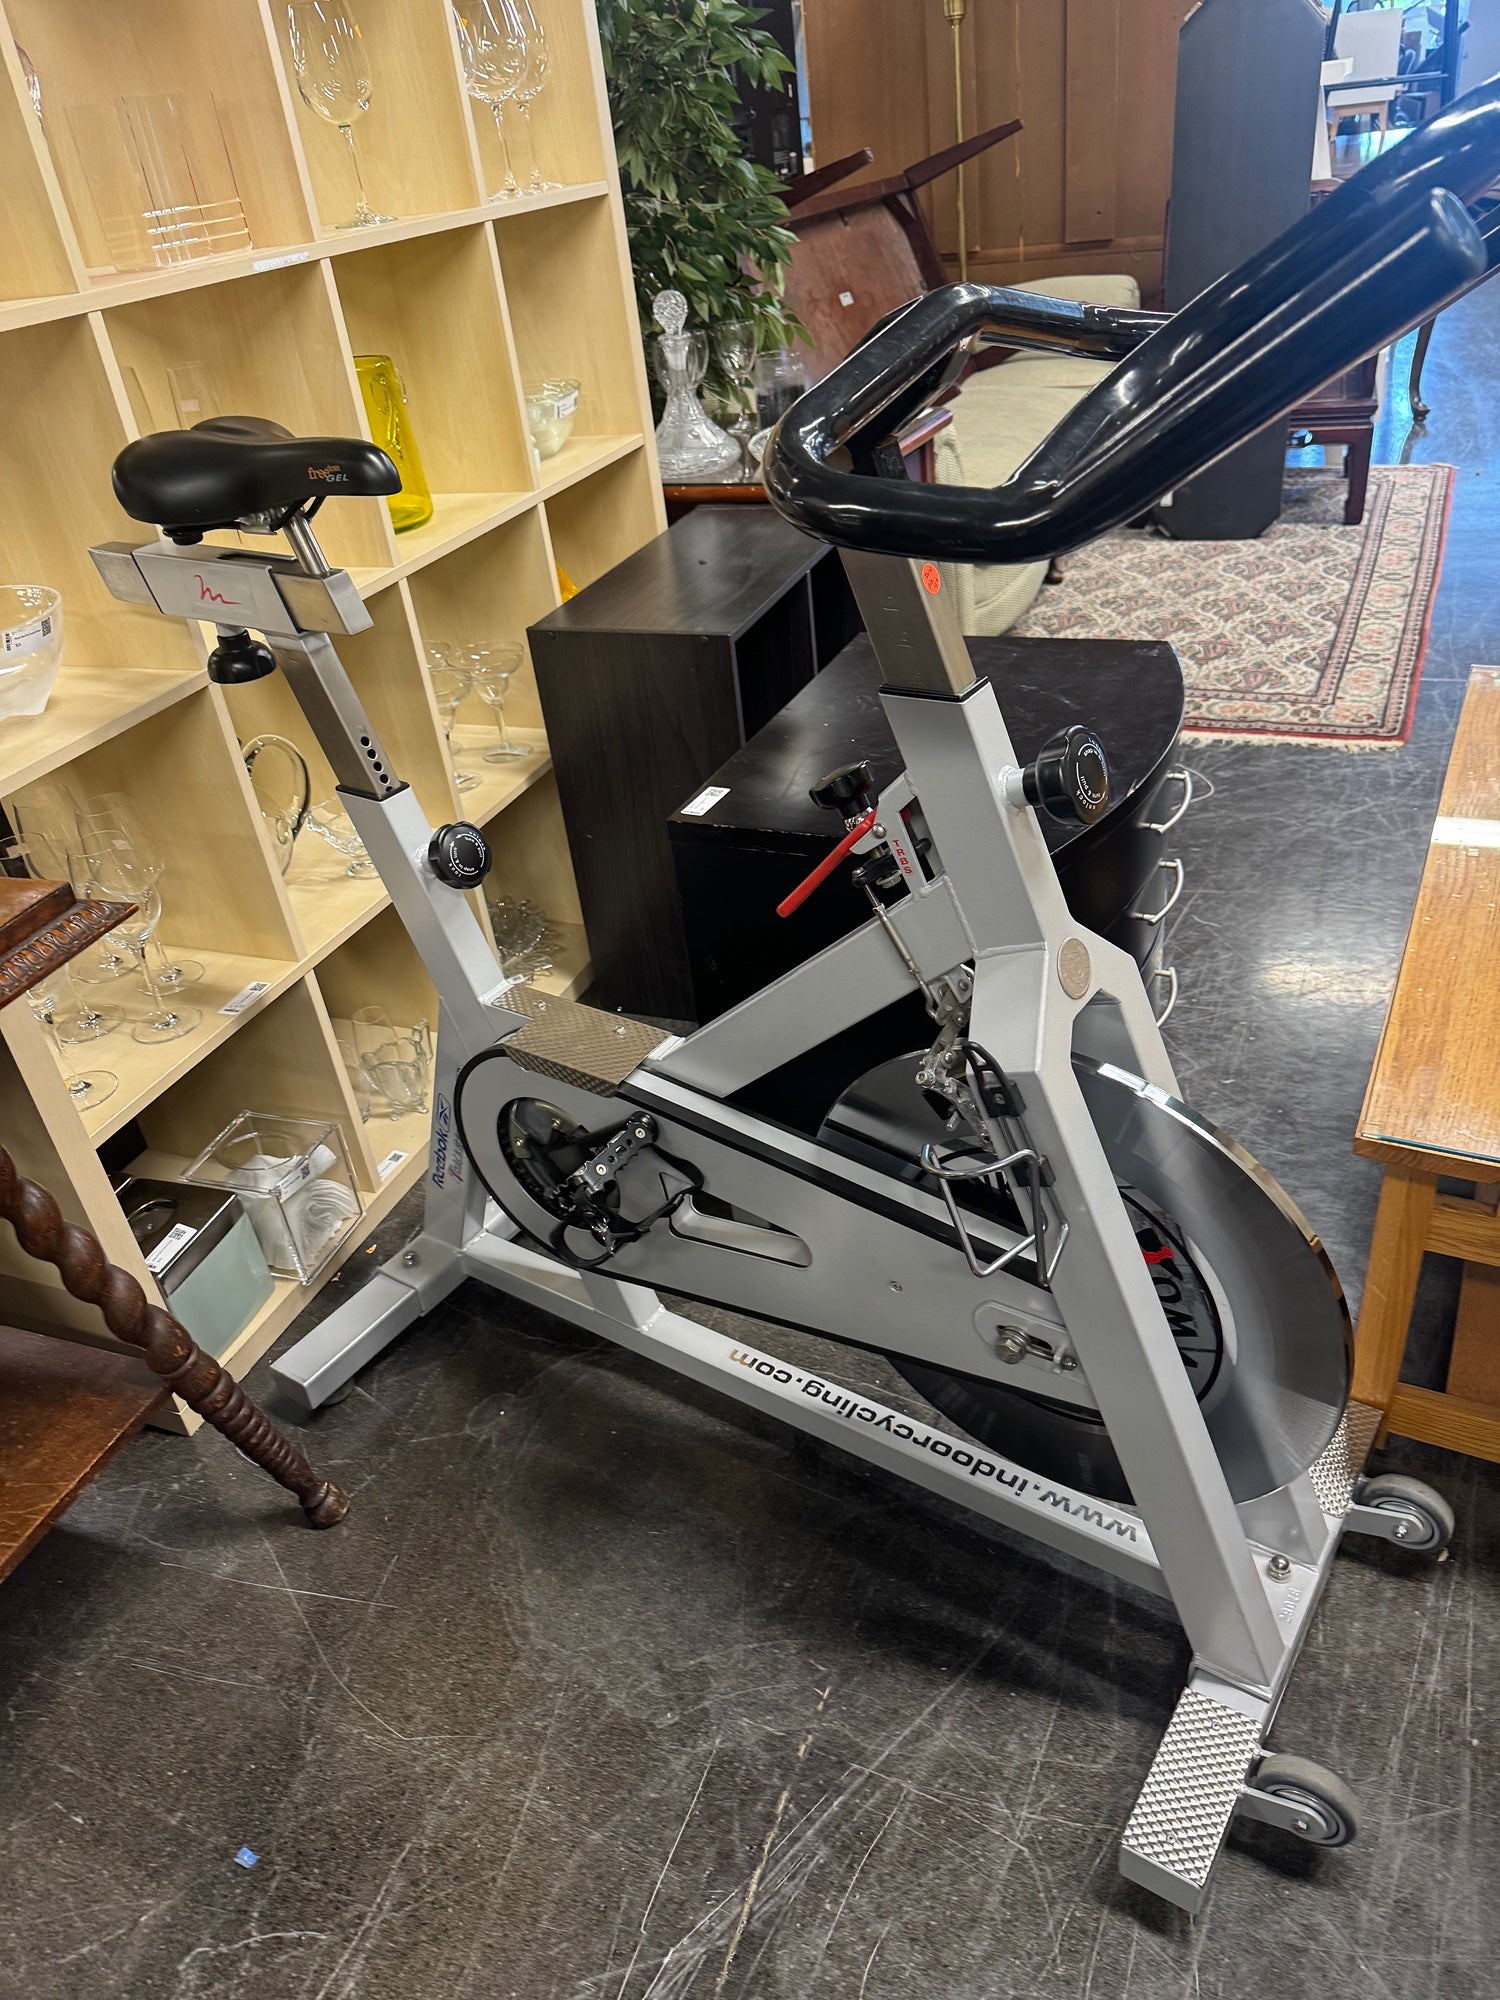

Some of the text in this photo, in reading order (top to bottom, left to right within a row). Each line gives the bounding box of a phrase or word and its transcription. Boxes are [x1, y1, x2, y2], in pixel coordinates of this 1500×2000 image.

[326, 473, 350, 482] GEL
[892, 839, 912, 874] TRBS
[432, 1128, 449, 1190] Reebok
[728, 1347, 1138, 1543] www.indoorcycling.com
